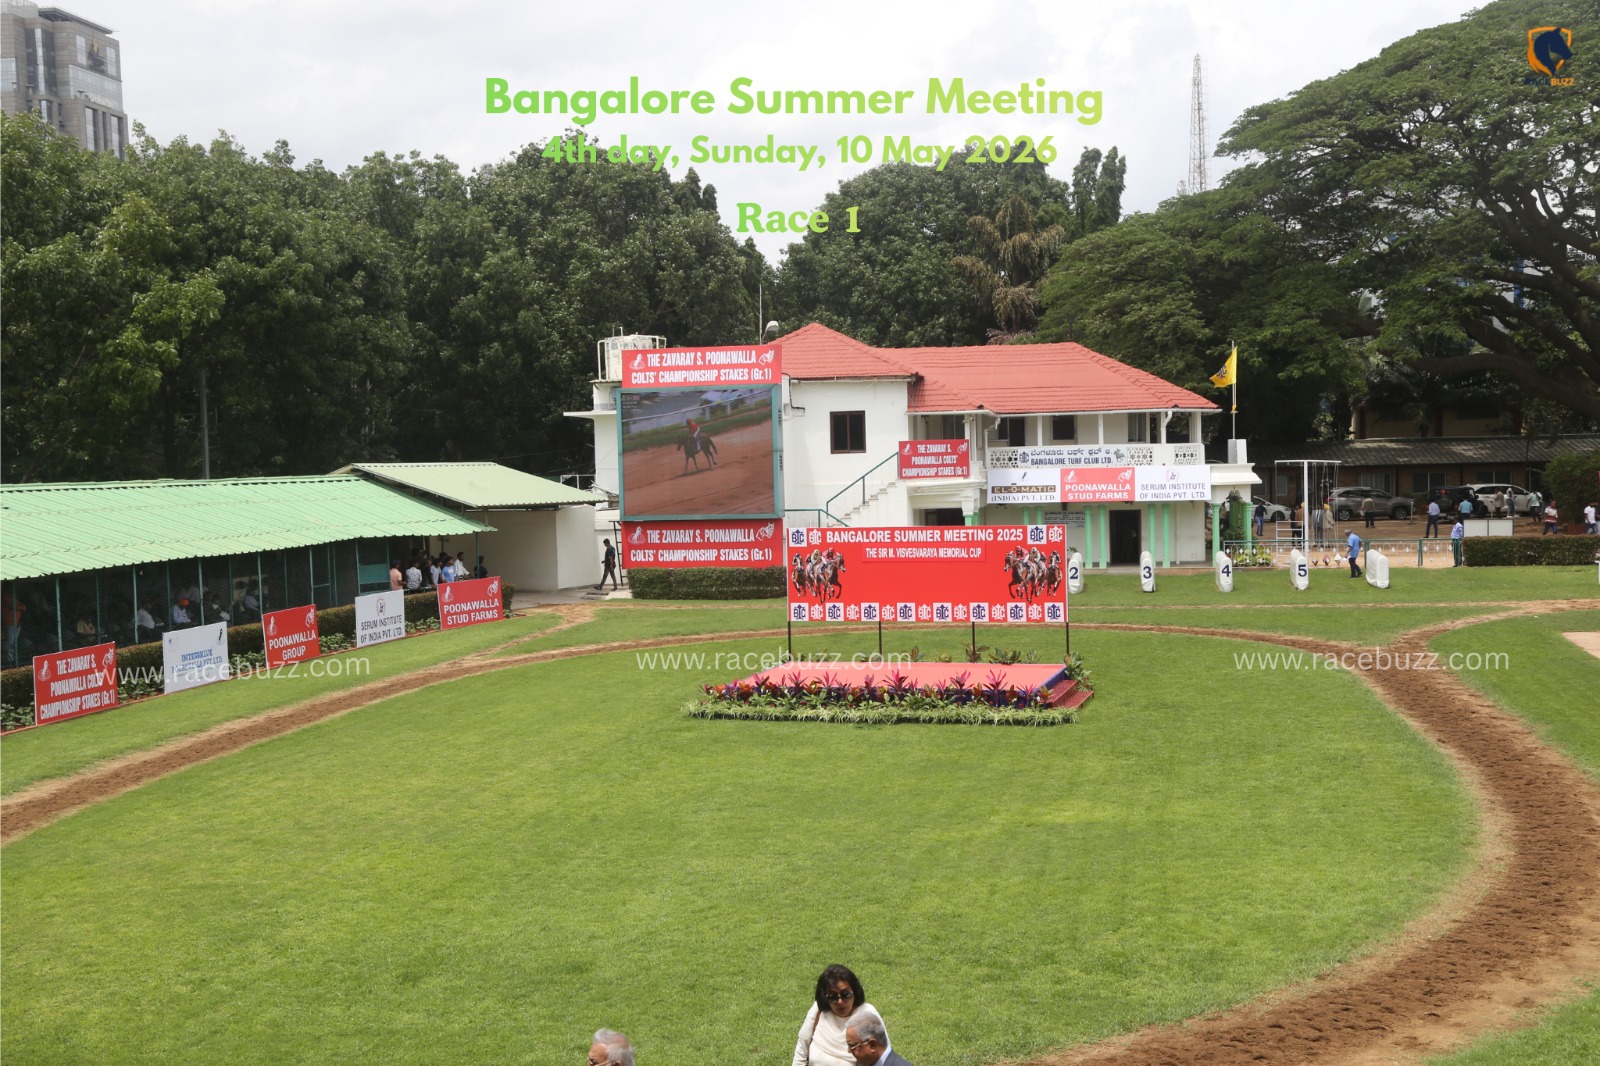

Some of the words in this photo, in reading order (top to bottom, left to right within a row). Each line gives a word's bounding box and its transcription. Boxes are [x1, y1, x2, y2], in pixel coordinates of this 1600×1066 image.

[647, 353, 660, 367] THE
[662, 352, 695, 367] ZAVARAY
[696, 351, 704, 365] S.
[706, 350, 757, 365] POONAWALLA
[659, 369, 718, 383] CHAMPIONSHIP
[720, 368, 749, 381] STAKES
[917, 444, 927, 453] THE
[1030, 457, 1066, 466] BANGALORE
[1068, 457, 1082, 465] TURF
[1084, 457, 1099, 465] CLUB
[1101, 456, 1113, 464] LTD.
[1065, 484, 1131, 492] POONAWALLA
[1141, 483, 1167, 491] SERUM
[991, 494, 1020, 502] (INDIA)
[1067, 492, 1093, 500] STUD
[1096, 491, 1129, 500] FARMS
[647, 529, 660, 543] THE
[662, 529, 694, 543] ZAVARAY
[695, 529, 702, 543] S.
[704, 528, 755, 543] POONAWALLA
[826, 530, 891, 543] BANGALORE
[893, 529, 942, 543] SUMMER
[944, 528, 994, 542] MEETING
[996, 528, 1023, 541] 2025
[658, 548, 718, 562] CHAMPIONSHIP
[720, 548, 749, 561] STAKES
[866, 547, 877, 558] THE
[878, 547, 888, 558] SIR
[896, 547, 937, 558] VISVESVARAYA
[938, 547, 969, 558] MEMORIAL
[969, 547, 982, 558] CUP
[1069, 566, 1079, 580] 2
[1142, 566, 1153, 579] 3
[1221, 565, 1231, 578] 4
[1297, 563, 1308, 577] 5
[443, 598, 500, 614] POONAWALLA
[361, 620, 378, 631] SERUM
[379, 615, 402, 628] INSTITUTE
[447, 614, 469, 625] STUD
[471, 609, 499, 622] FARMS
[269, 630, 317, 650] POONAWALLA
[360, 635, 368, 643] OF
[369, 631, 382, 642] INDIA
[282, 645, 306, 660] GROUP
[56, 659, 67, 675] THE
[51, 675, 87, 697] POONAWALLA
[40, 696, 81, 720] CHAMPIONSHIP
[82, 691, 101, 710] STAKES
